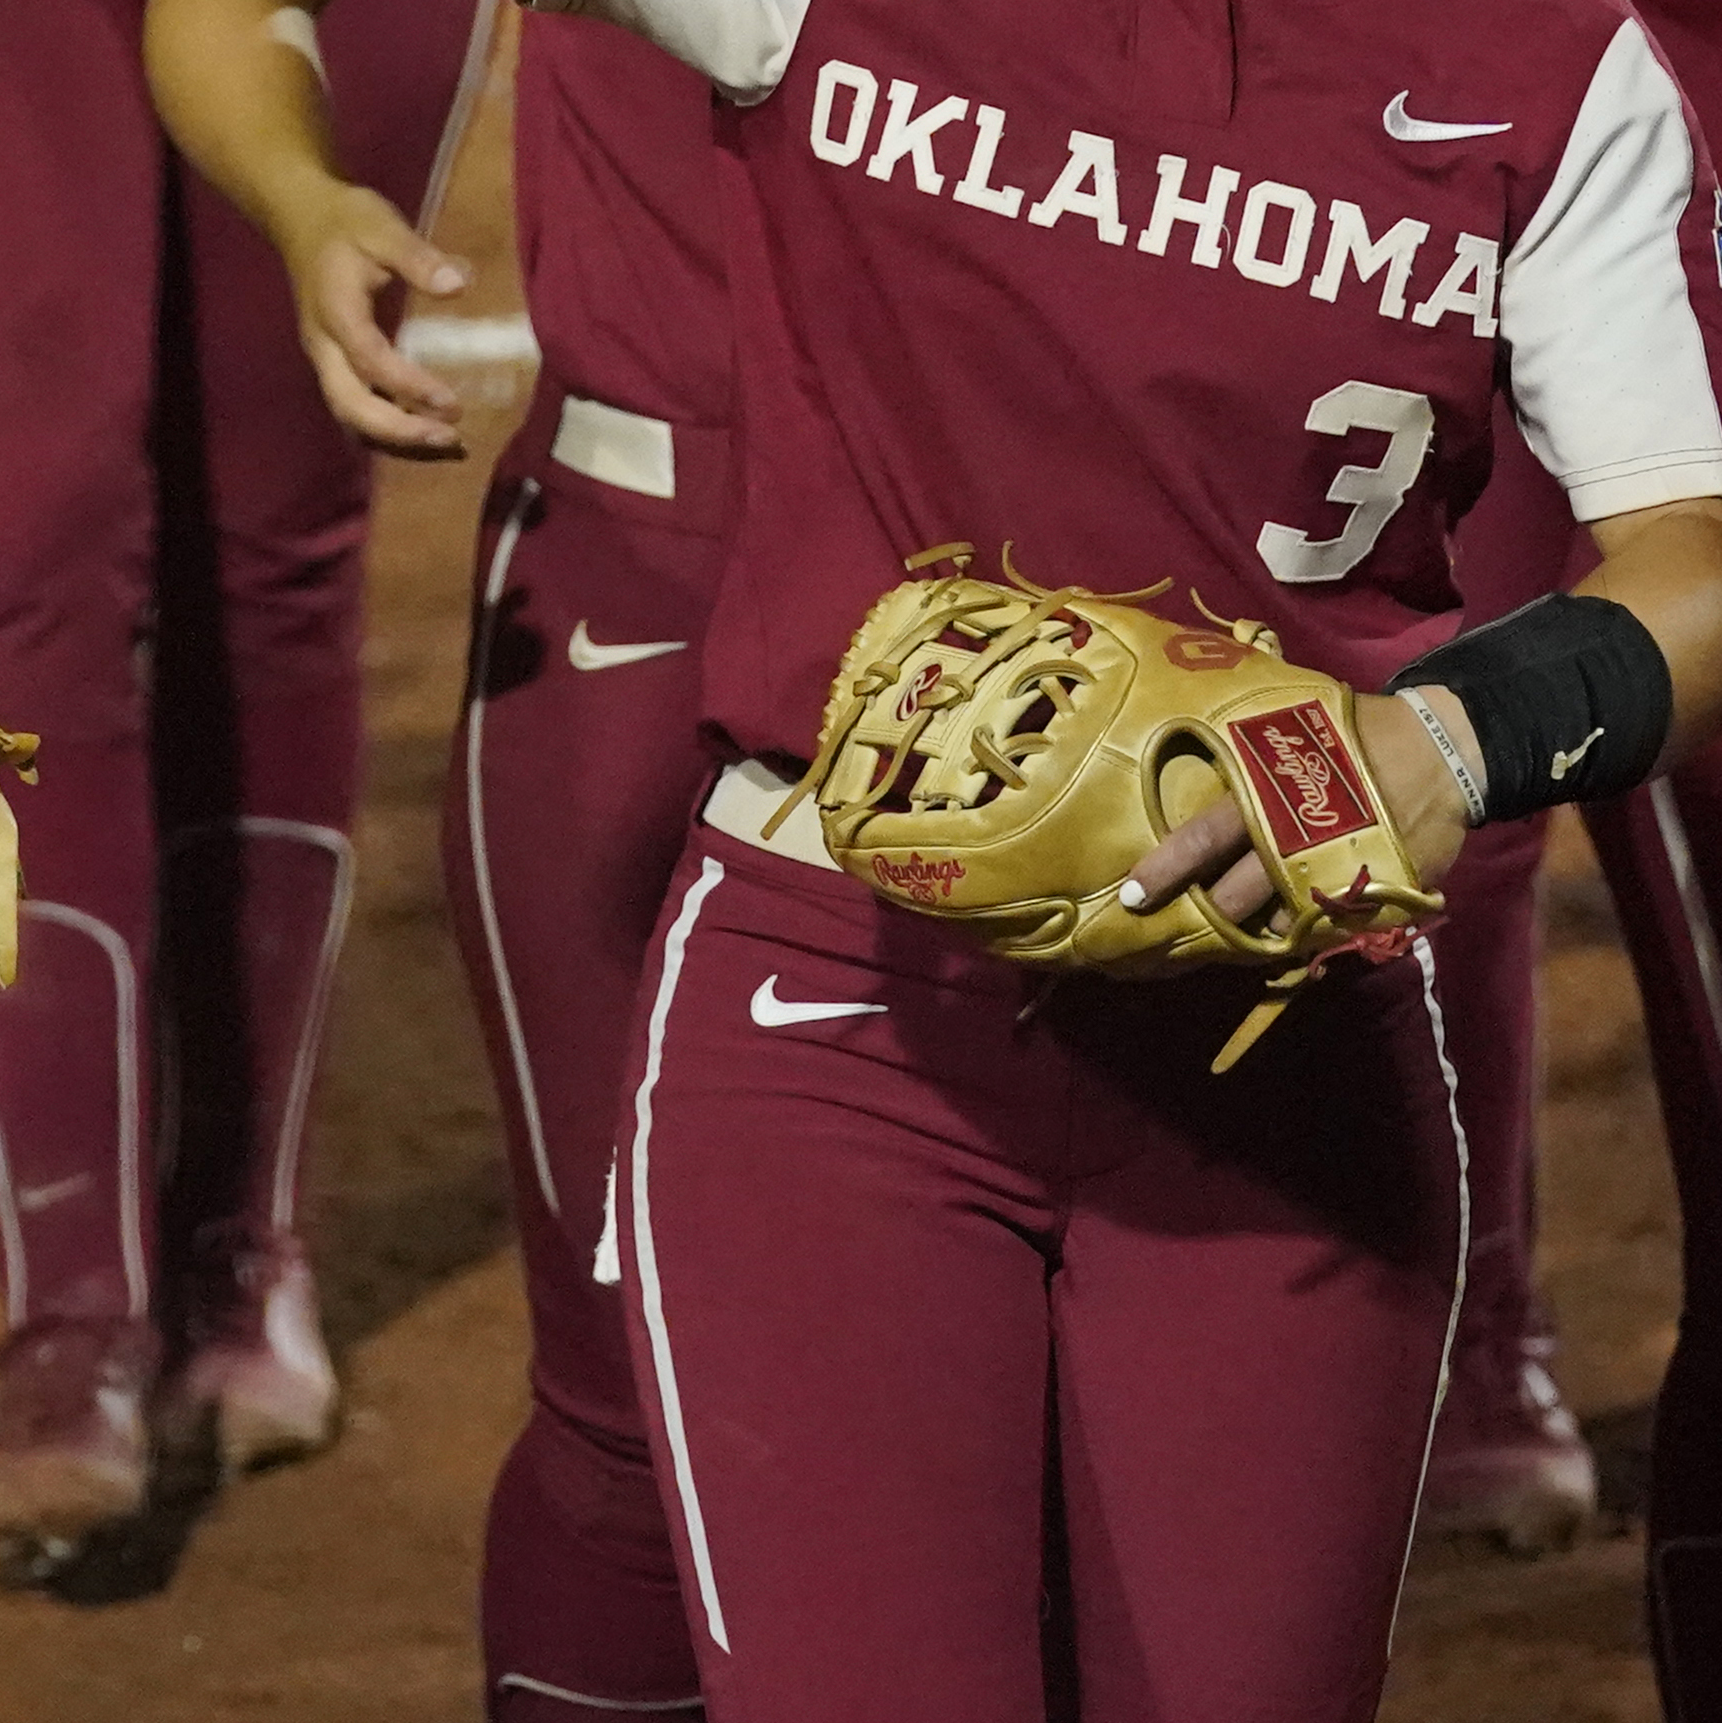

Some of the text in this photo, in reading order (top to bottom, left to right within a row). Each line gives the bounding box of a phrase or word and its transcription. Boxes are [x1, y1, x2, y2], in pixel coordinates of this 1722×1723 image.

[809, 58, 1504, 339] OKLAHOMA
[1256, 379, 1436, 584] 3
[1262, 725, 1340, 828] Rawlings
[1430, 724, 1455, 758] LUKE
[872, 850, 967, 898] Rawlings
